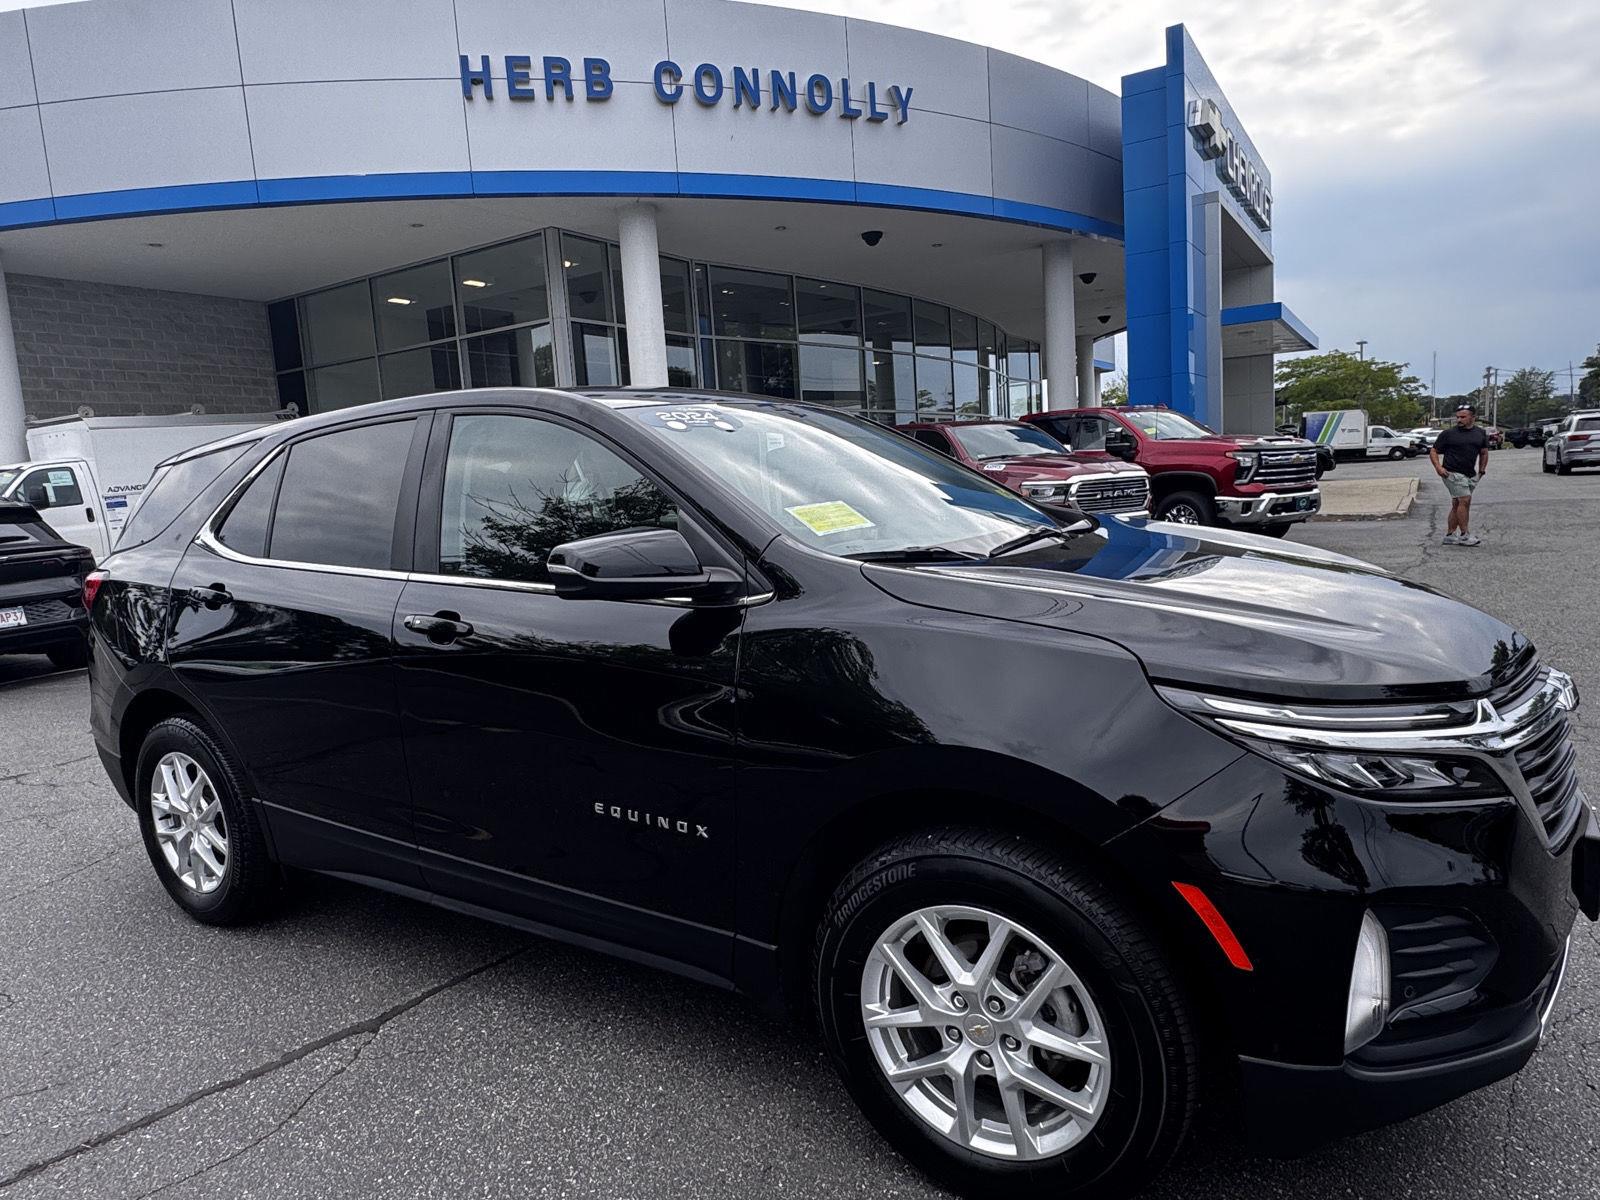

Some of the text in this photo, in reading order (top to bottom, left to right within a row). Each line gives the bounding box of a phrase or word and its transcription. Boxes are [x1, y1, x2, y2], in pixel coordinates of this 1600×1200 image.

[459, 54, 914, 126] HERB CONNOLLY
[1220, 128, 1273, 230] CHEVROLE
[656, 411, 719, 421] 2024
[1103, 489, 1136, 498] RAM
[594, 802, 709, 839] EQUINOX
[834, 862, 917, 928] BRIDGESTONE
